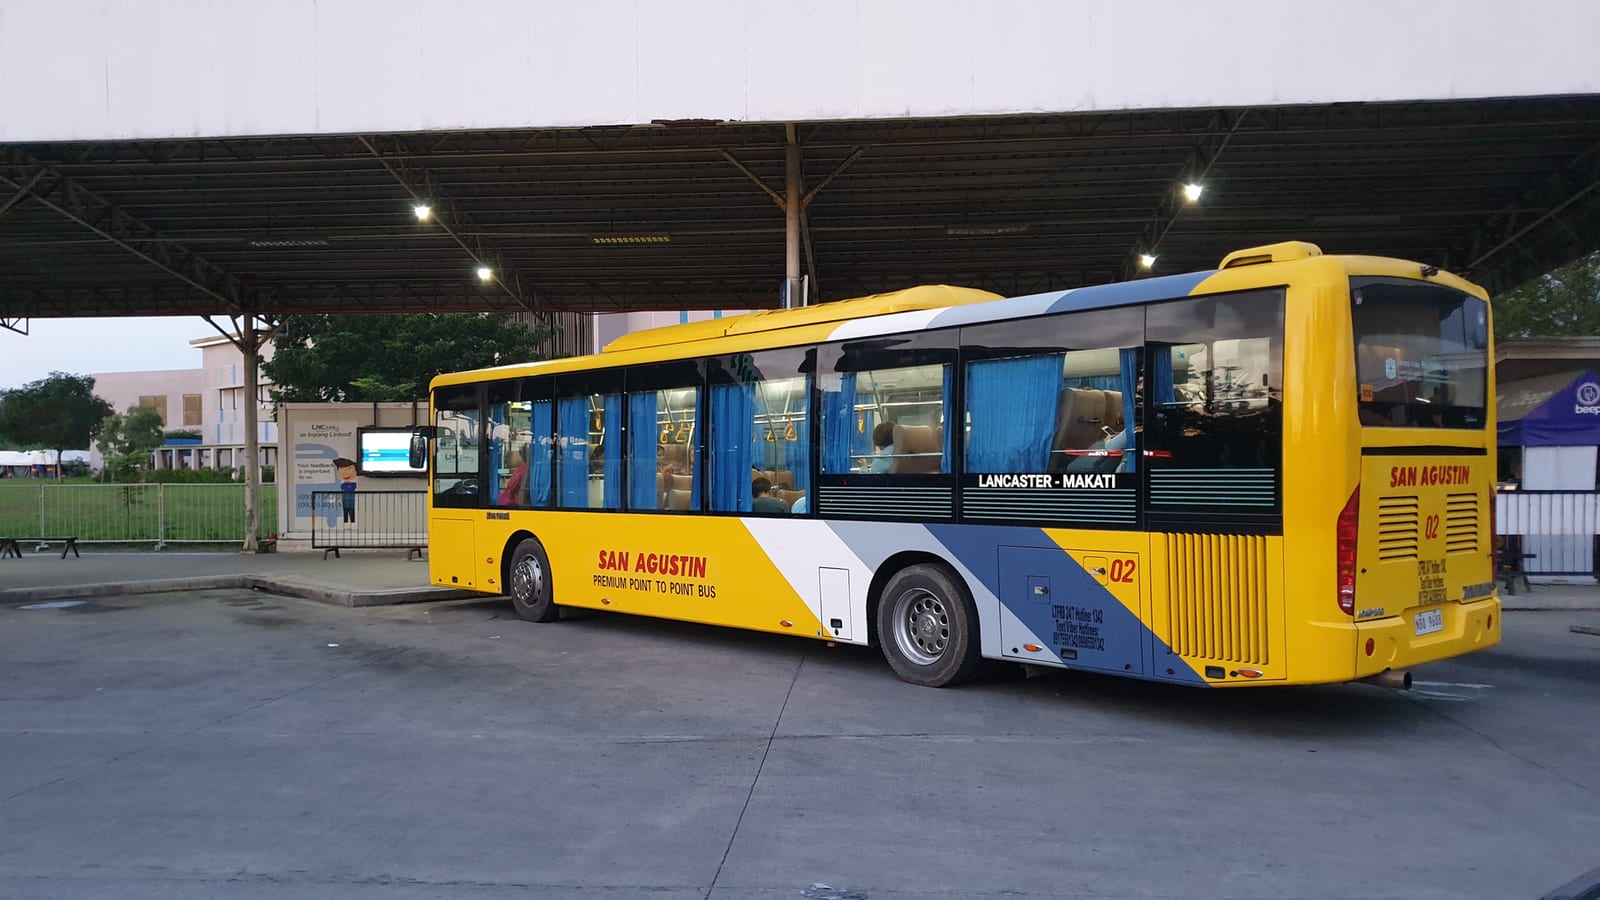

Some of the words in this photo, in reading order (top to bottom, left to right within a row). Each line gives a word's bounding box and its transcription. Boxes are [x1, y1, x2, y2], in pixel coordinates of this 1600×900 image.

[979, 474, 1053, 488] LANCASTER
[1062, 474, 1116, 489] MAKATI
[1390, 466, 1417, 488] SAN
[1421, 465, 1470, 486] AGUSTIN
[1425, 514, 1440, 540] 02
[598, 549, 629, 572] SAN
[634, 552, 707, 578] AGUSTIN
[1110, 558, 1136, 583] 02
[593, 575, 627, 590] PREMIUM
[629, 578, 652, 593] POINT
[656, 580, 667, 594] TO
[670, 582, 694, 597] POINT
[698, 584, 716, 599] BUS
